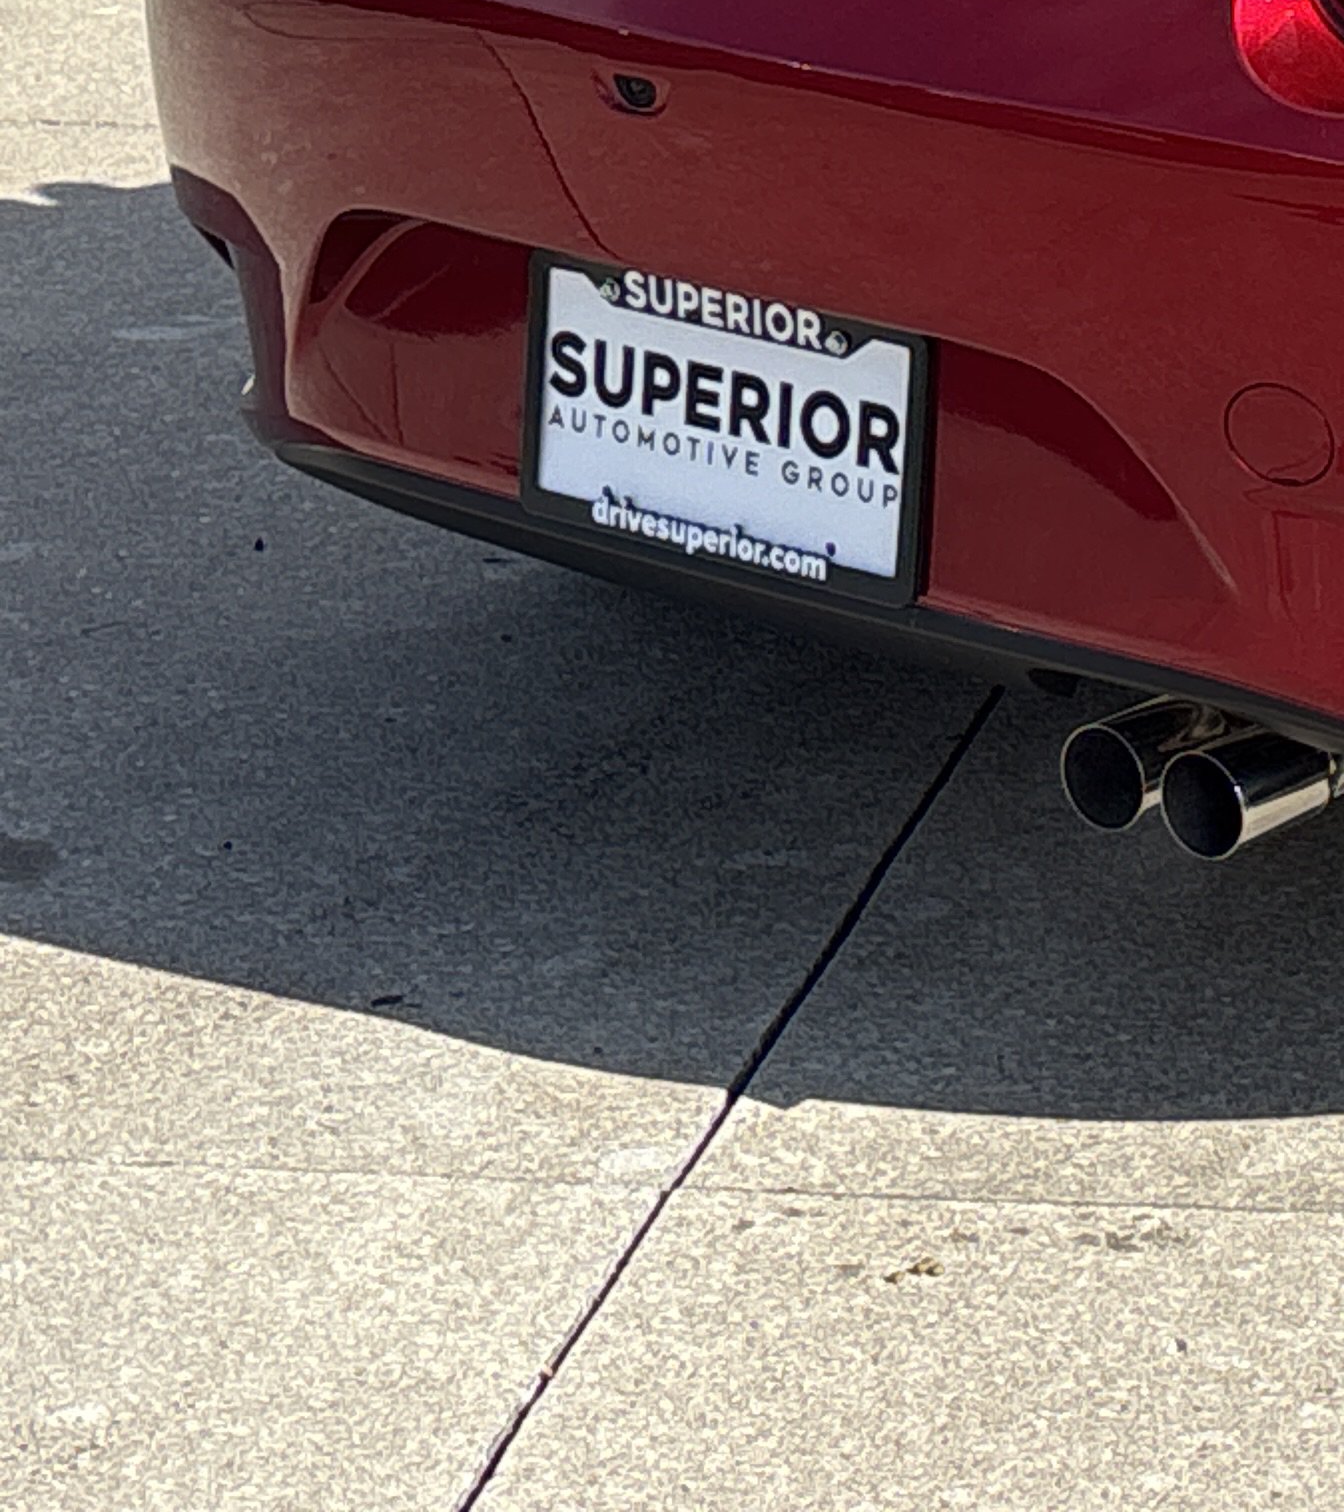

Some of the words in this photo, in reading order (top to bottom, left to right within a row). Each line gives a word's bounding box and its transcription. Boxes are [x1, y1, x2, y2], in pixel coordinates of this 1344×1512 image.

[622, 269, 823, 350] SUPERIOR
[549, 330, 900, 475] SUPERIOR
[548, 405, 761, 477] AUTOMOTIVE
[781, 459, 899, 508] GROUP
[591, 494, 827, 582] drivesuperior.com
